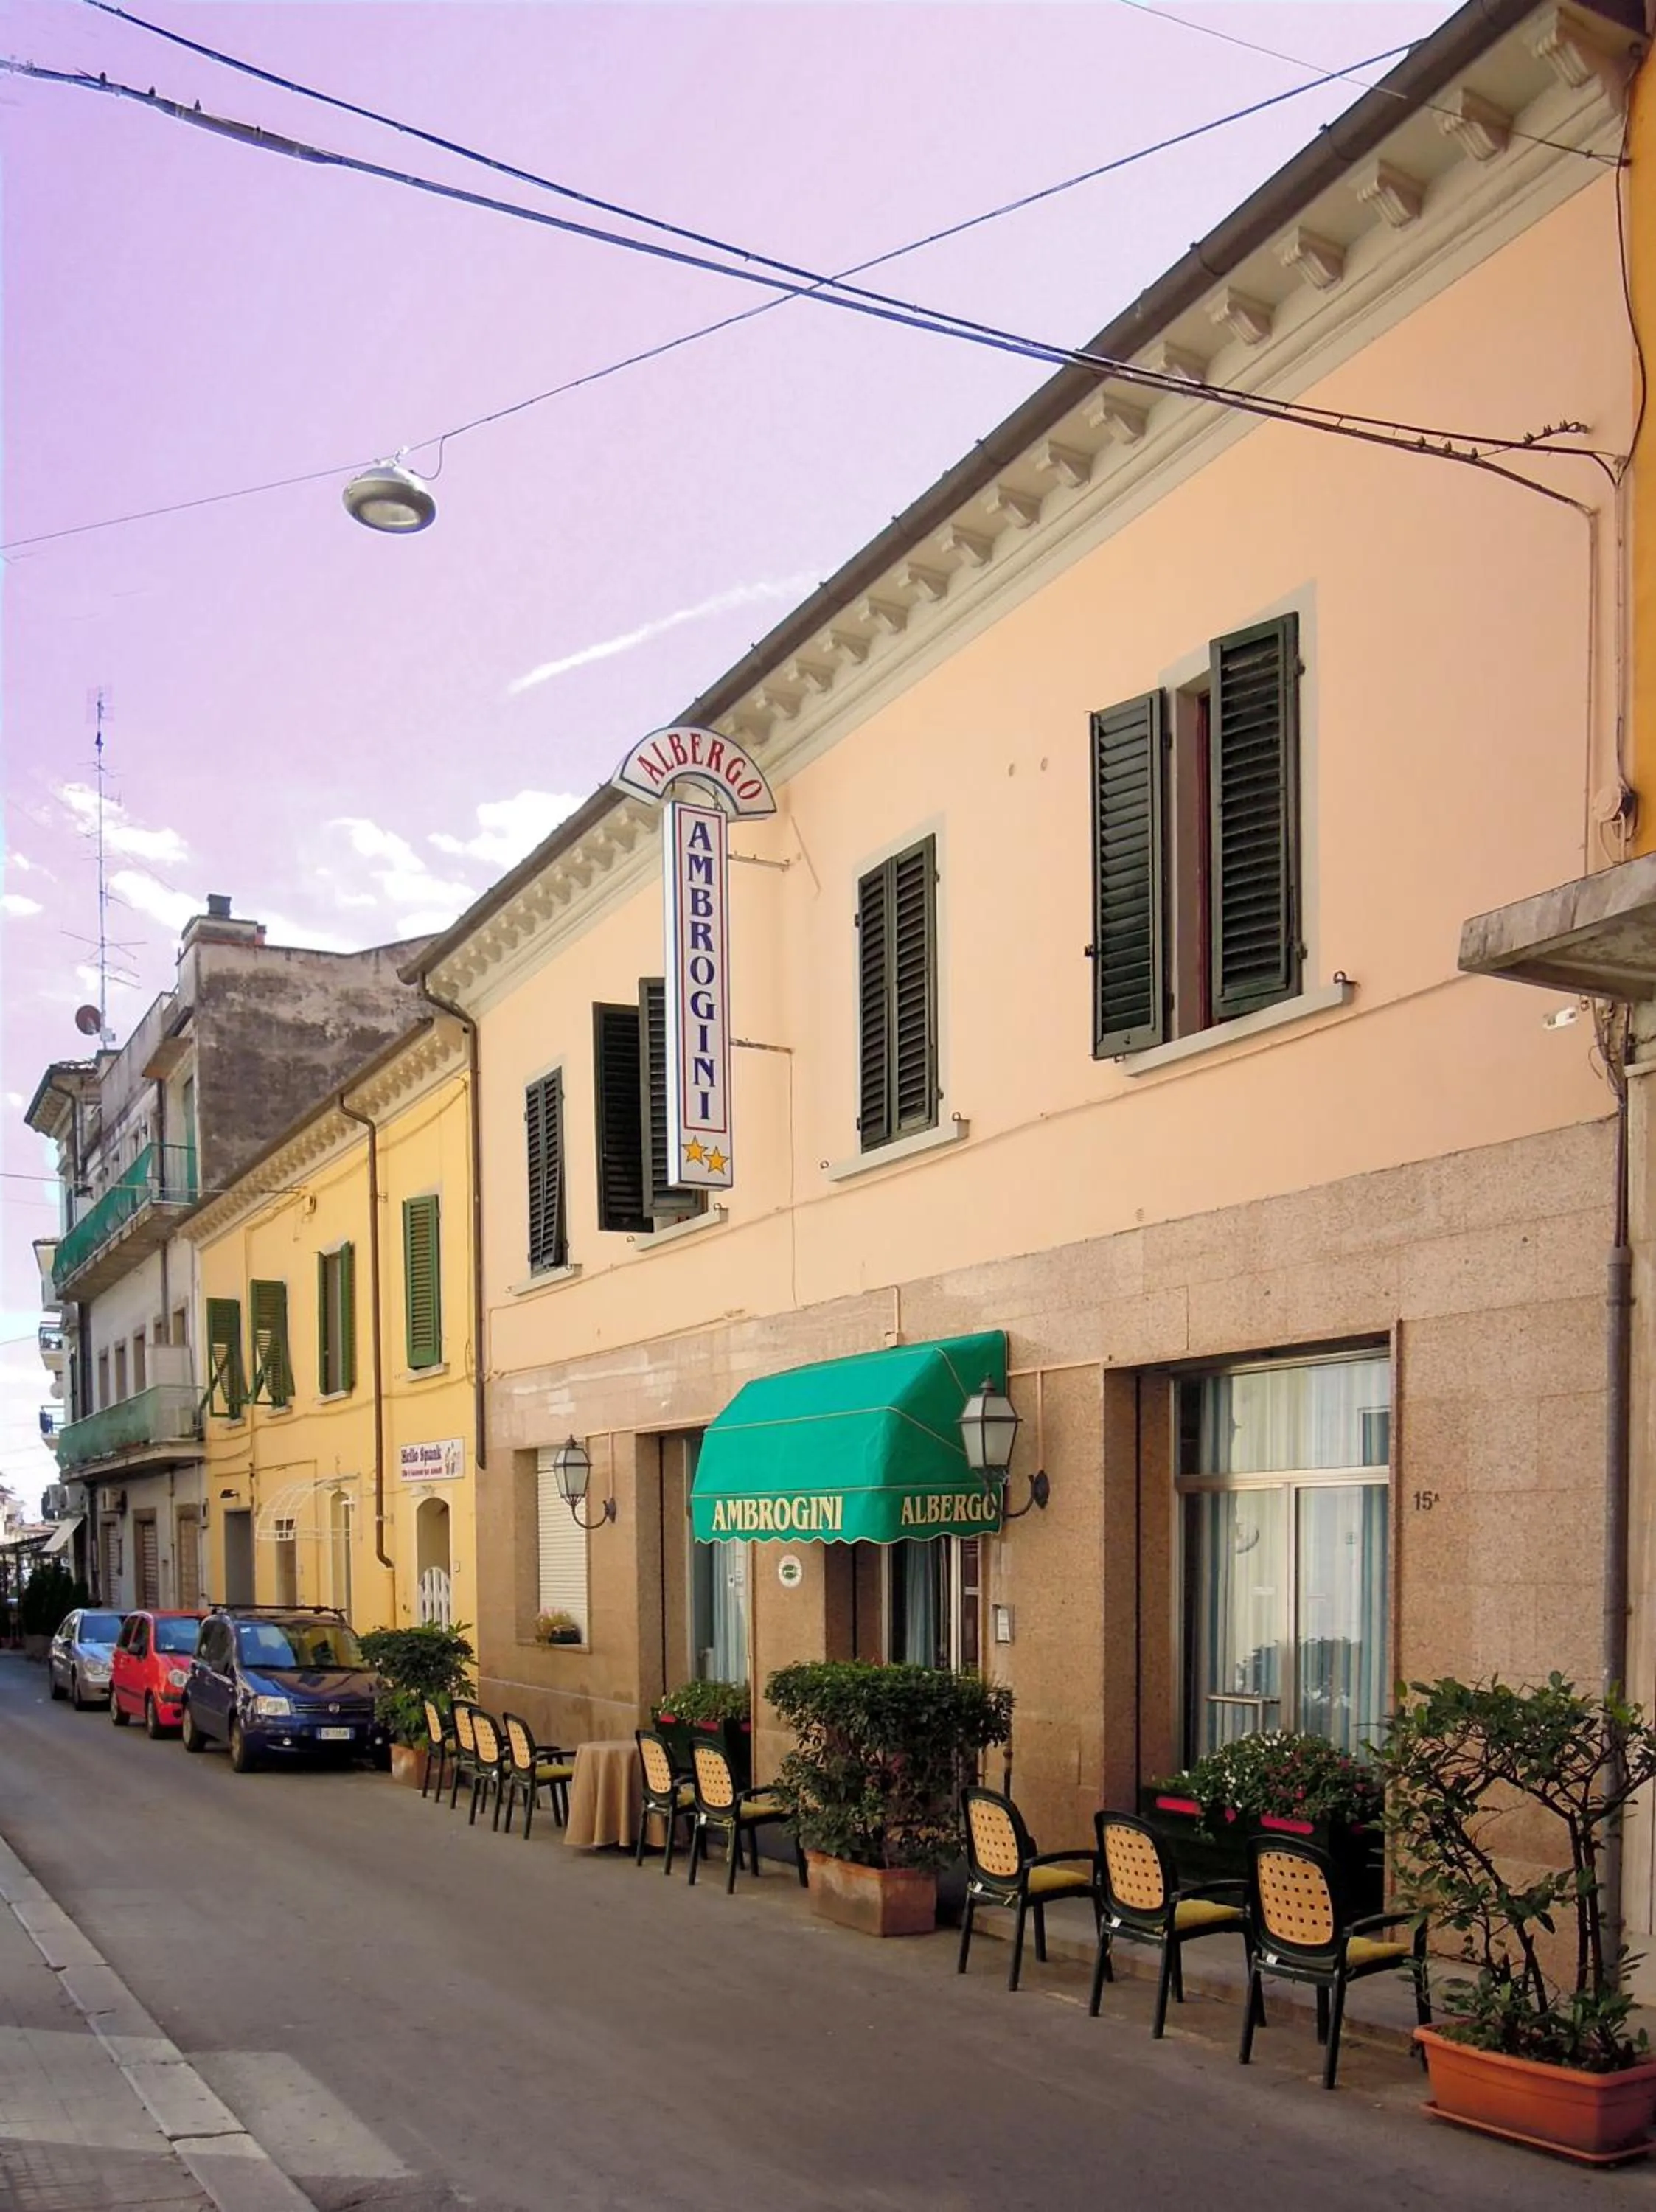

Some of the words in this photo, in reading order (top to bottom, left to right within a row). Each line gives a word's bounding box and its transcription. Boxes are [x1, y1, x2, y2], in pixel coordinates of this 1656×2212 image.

[636, 733, 762, 801] ALBERGO
[688, 820, 715, 1121] AMBROGINI
[712, 1495, 843, 1531] AMBROGINI
[901, 1492, 998, 1526] ALBERGO
